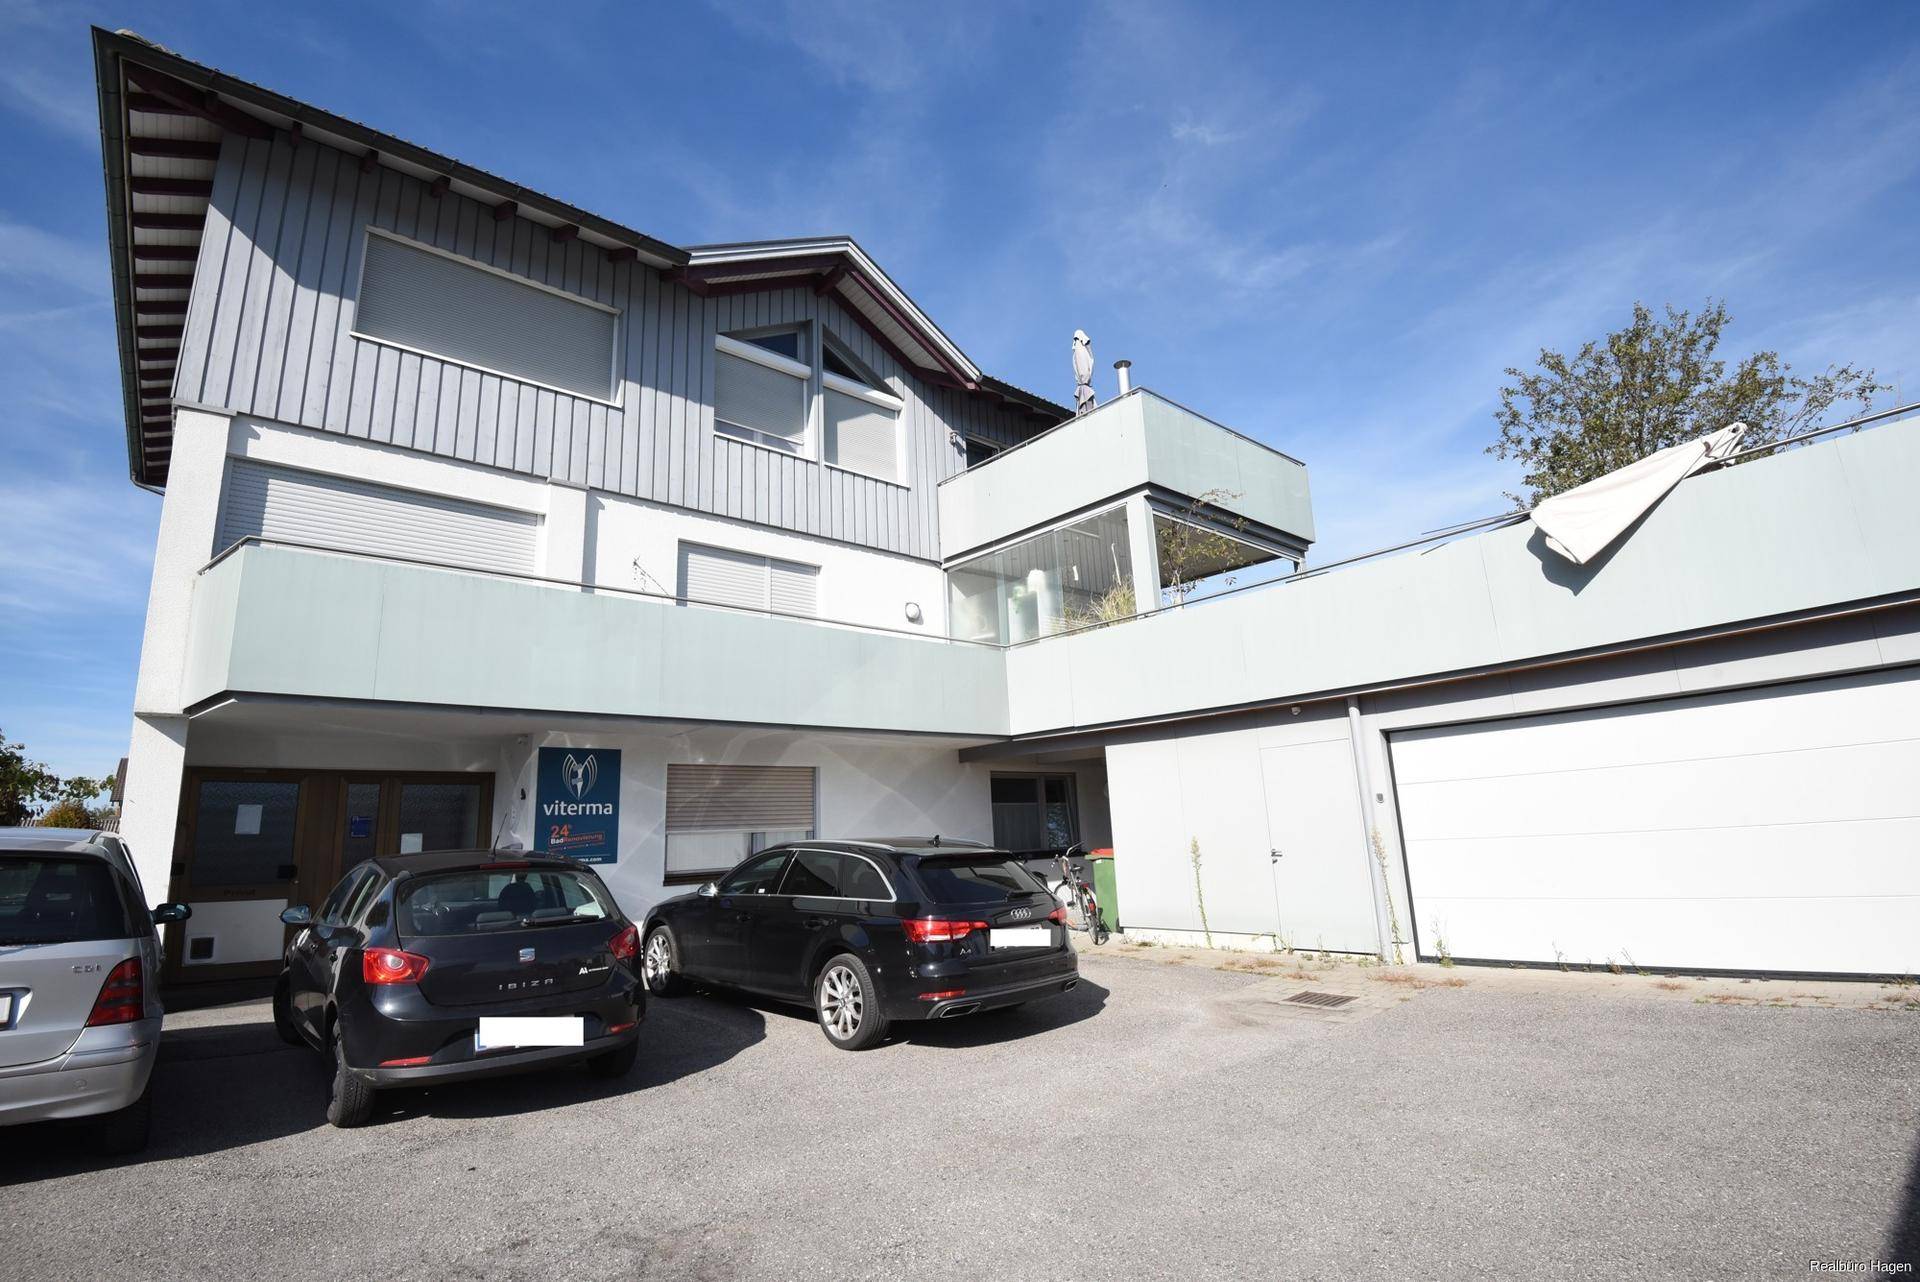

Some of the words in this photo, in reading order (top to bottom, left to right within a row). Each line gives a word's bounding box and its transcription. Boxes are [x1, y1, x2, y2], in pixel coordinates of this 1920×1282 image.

[543, 800, 613, 816] viterma
[72, 963, 102, 974] CDI
[499, 978, 553, 991] IBIZA
